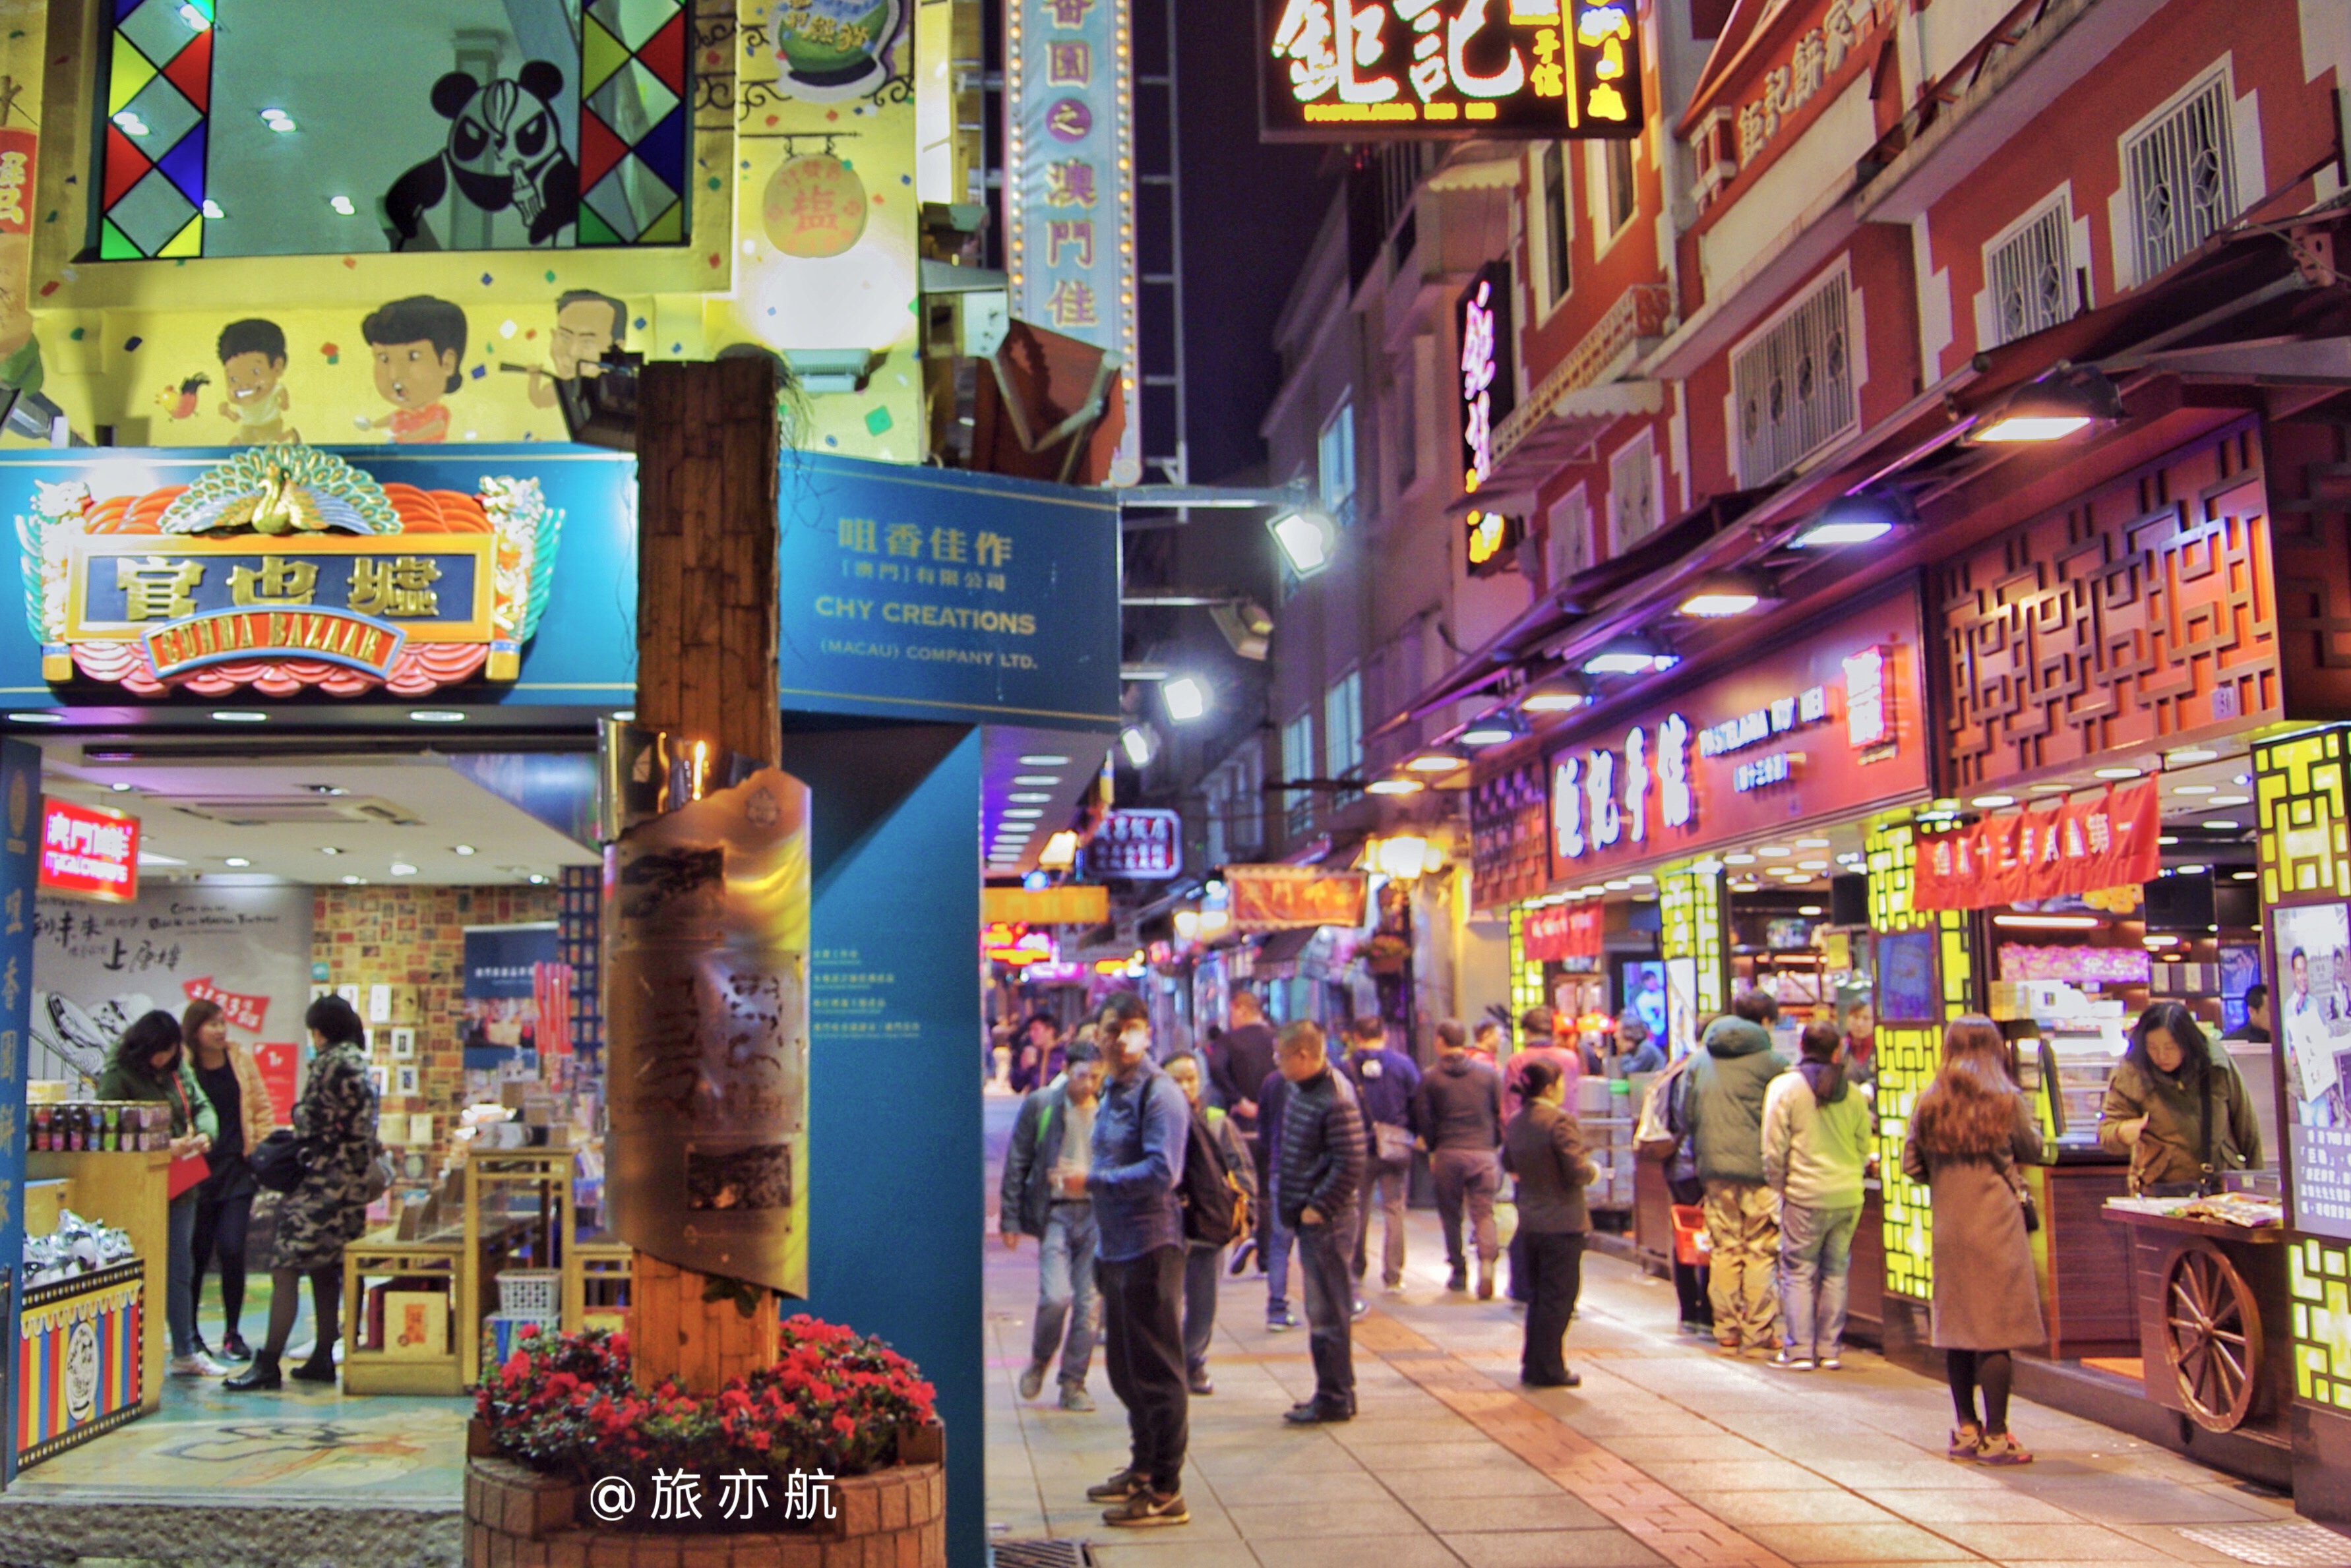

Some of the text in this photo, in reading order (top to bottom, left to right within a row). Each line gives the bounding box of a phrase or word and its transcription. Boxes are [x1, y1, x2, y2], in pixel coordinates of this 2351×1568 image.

[838, 518, 1014, 568] 咀香佳作
[116, 555, 442, 622] 官也墟
[160, 611, 382, 663] CUNHA BAZAAR
[815, 596, 1037, 636] CHY CREATIONS
[820, 639, 1039, 671] (MACAU) COMPANY LTD.
